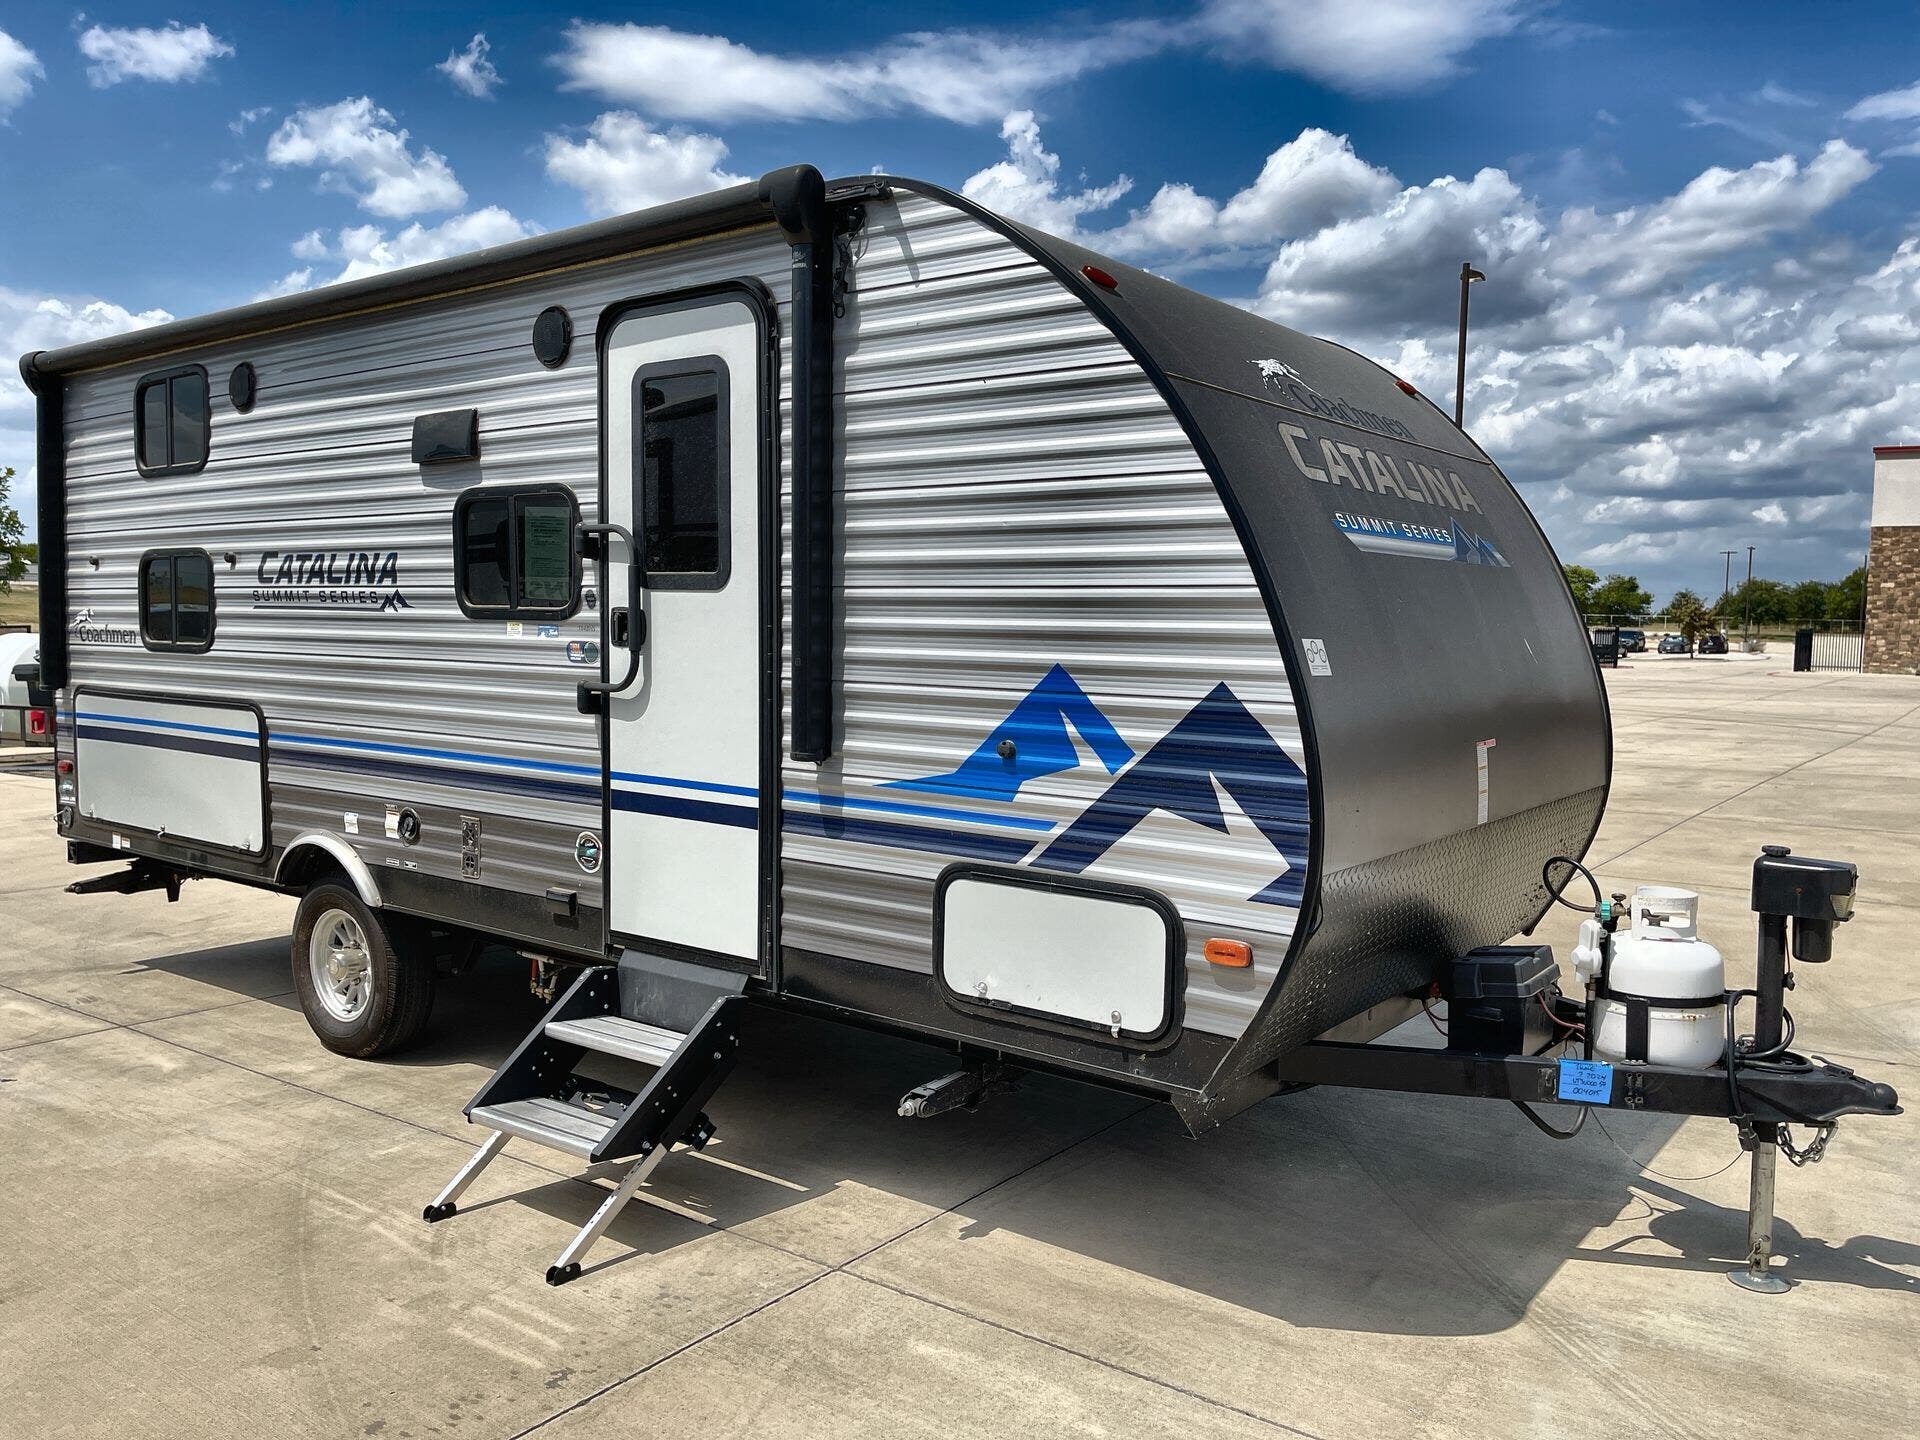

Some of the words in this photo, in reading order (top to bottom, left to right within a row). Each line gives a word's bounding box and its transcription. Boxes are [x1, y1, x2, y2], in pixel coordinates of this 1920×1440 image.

[1287, 383, 1417, 440] Coachmen
[1277, 420, 1484, 515] CATALINA
[1335, 512, 1398, 535] SUMMIT
[1401, 522, 1453, 544] SERIES
[257, 551, 399, 585] CATALINA
[252, 589, 309, 603] SUMMIT
[318, 590, 379, 605] SERIES
[79, 624, 137, 645] Coachmen
